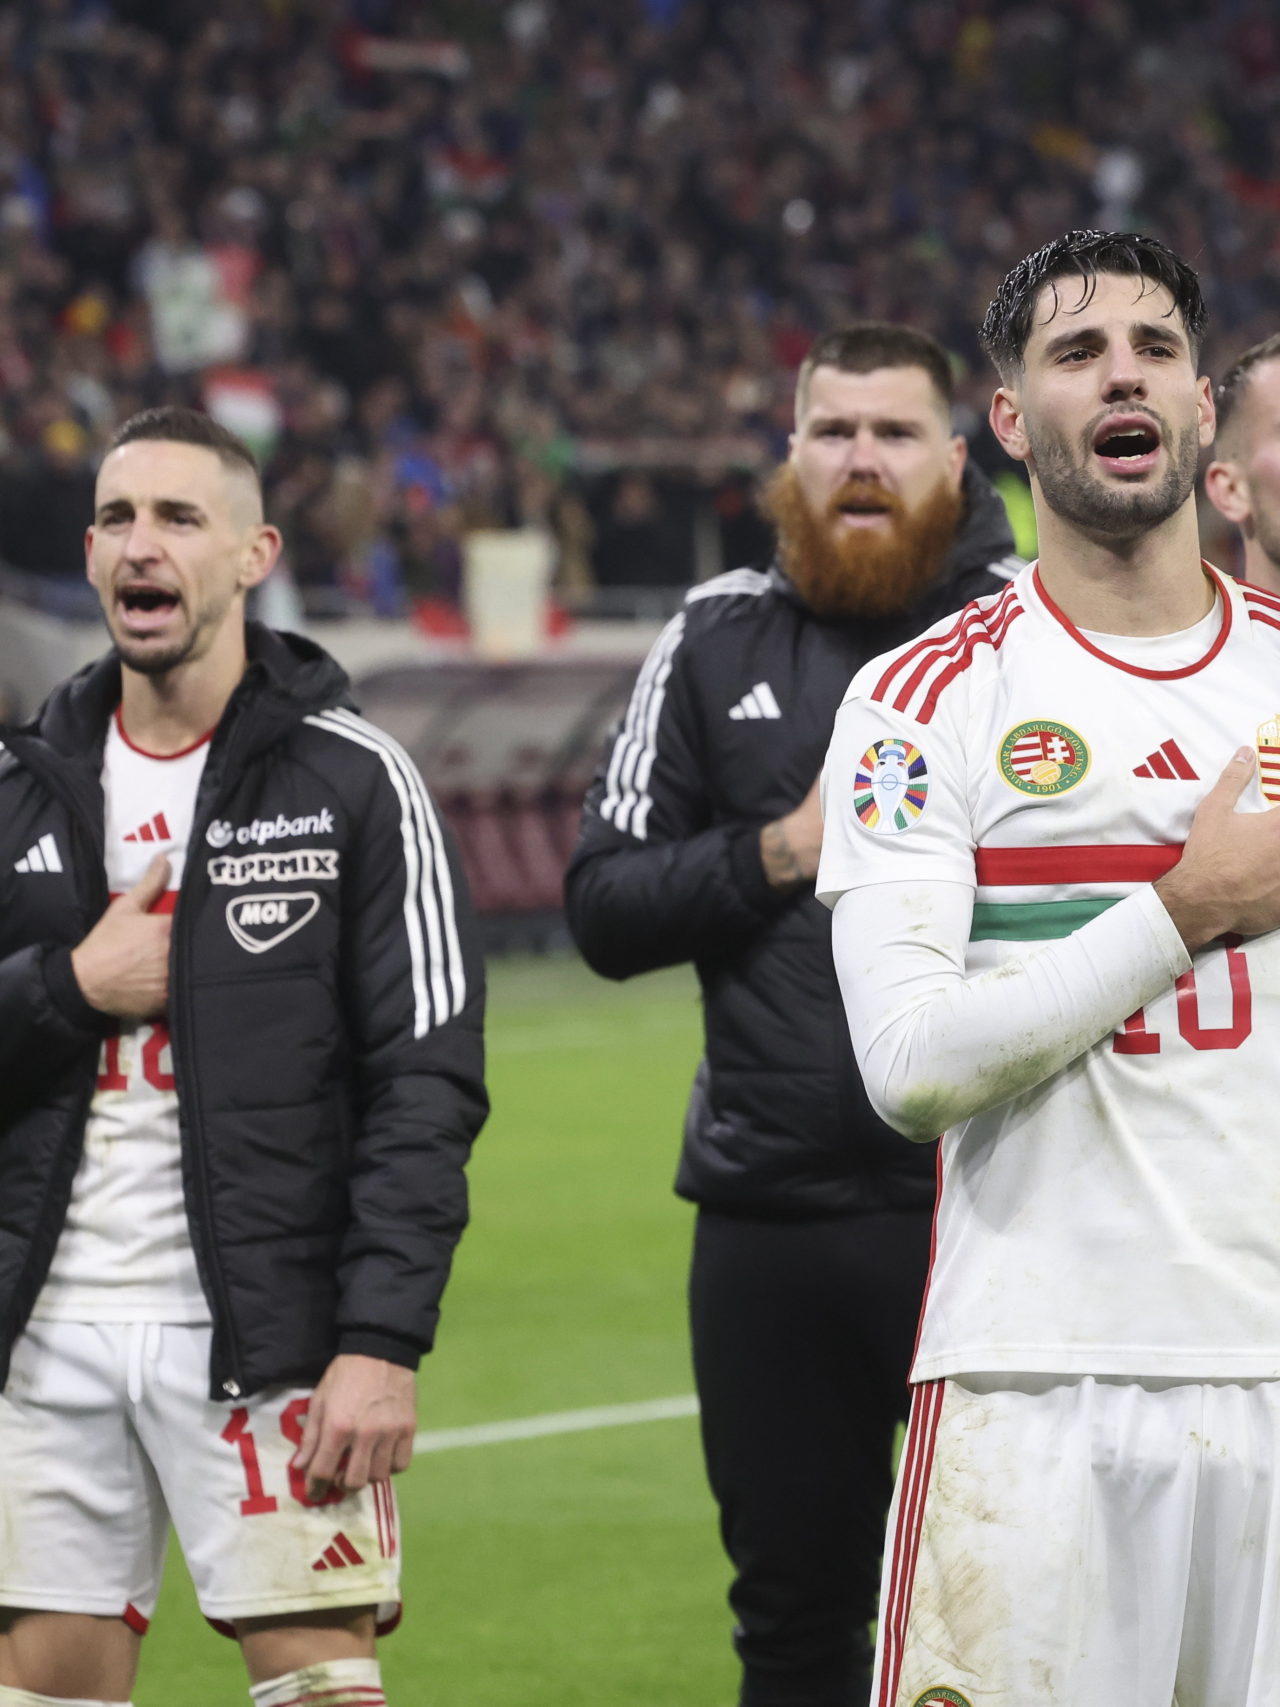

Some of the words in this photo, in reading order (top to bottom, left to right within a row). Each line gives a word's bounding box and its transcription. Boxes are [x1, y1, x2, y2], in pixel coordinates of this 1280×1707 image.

[1036, 782, 1063, 793] 1901
[236, 807, 334, 846] otpbank
[239, 900, 290, 926] MOL
